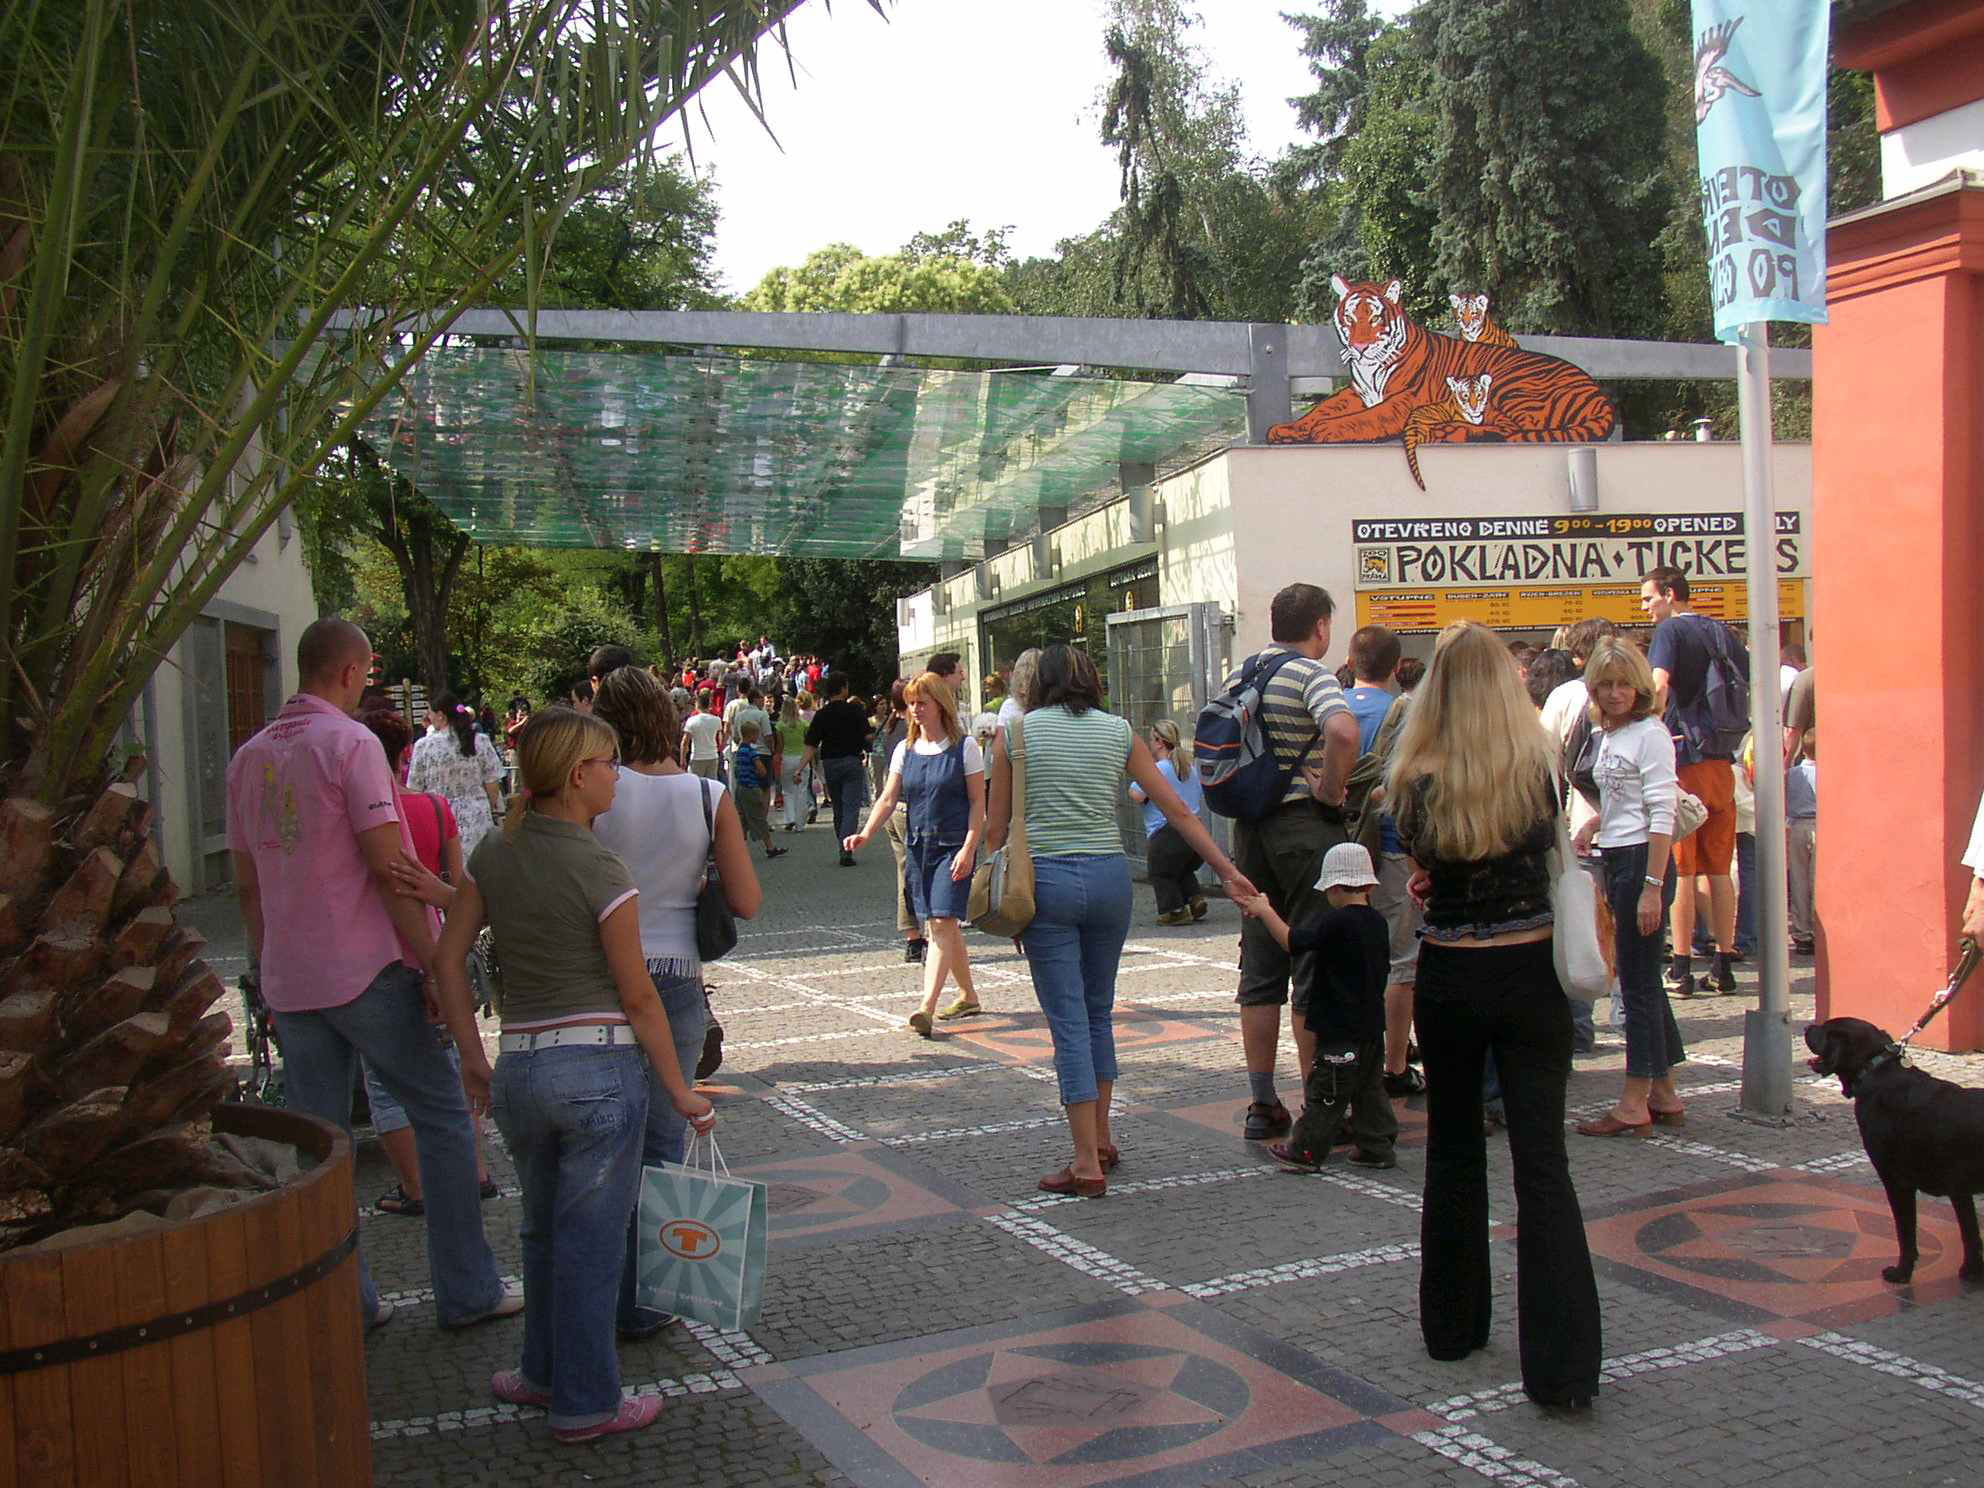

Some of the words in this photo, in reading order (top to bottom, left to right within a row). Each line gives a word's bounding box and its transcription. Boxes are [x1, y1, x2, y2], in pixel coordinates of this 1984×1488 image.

[1653, 516, 1737, 533] OPENED
[1396, 543, 1612, 582] POKLADNA
[1627, 538, 1800, 577] TICKES
